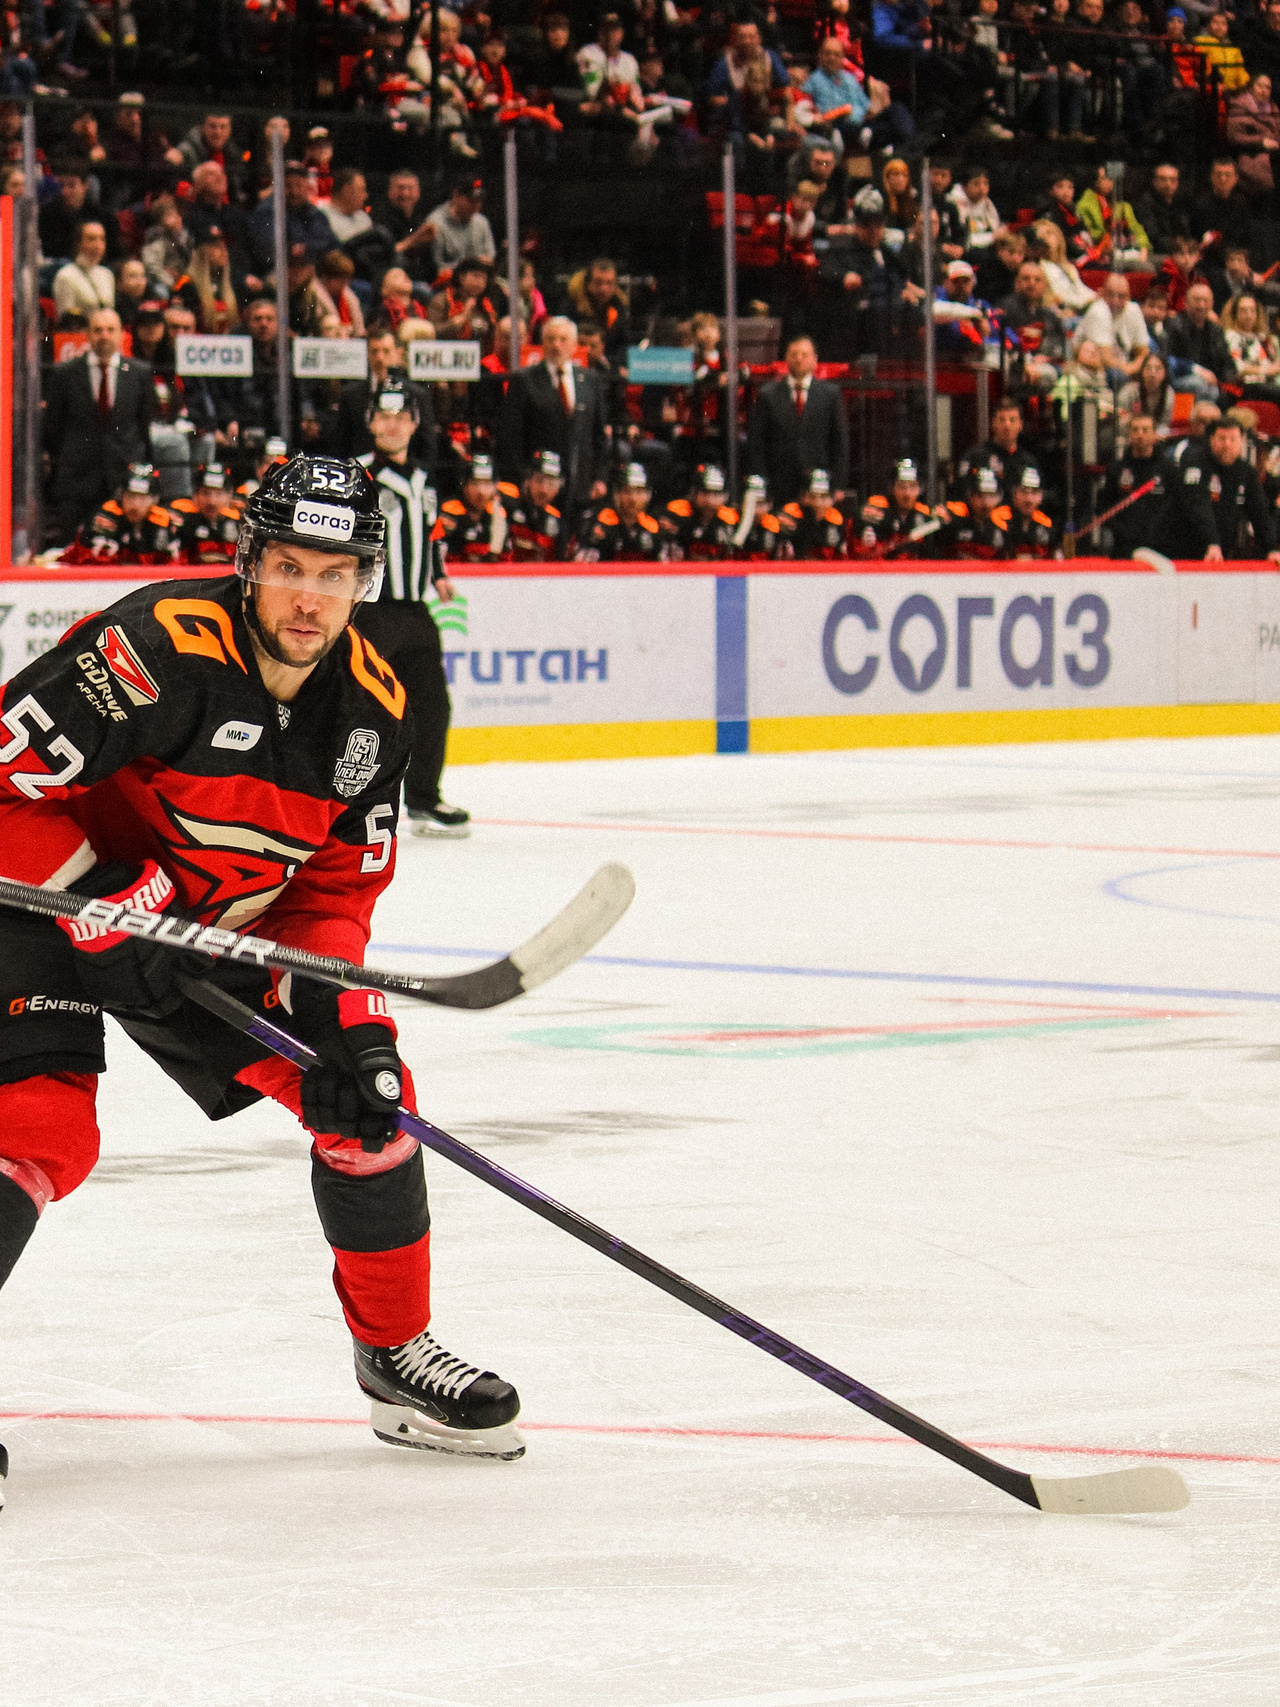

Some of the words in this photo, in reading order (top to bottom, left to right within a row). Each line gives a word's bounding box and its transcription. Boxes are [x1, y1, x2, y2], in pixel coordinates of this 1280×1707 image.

[312, 468, 346, 492] 52
[76, 682, 108, 718] АРЕНА
[226, 728, 250, 741] МИР
